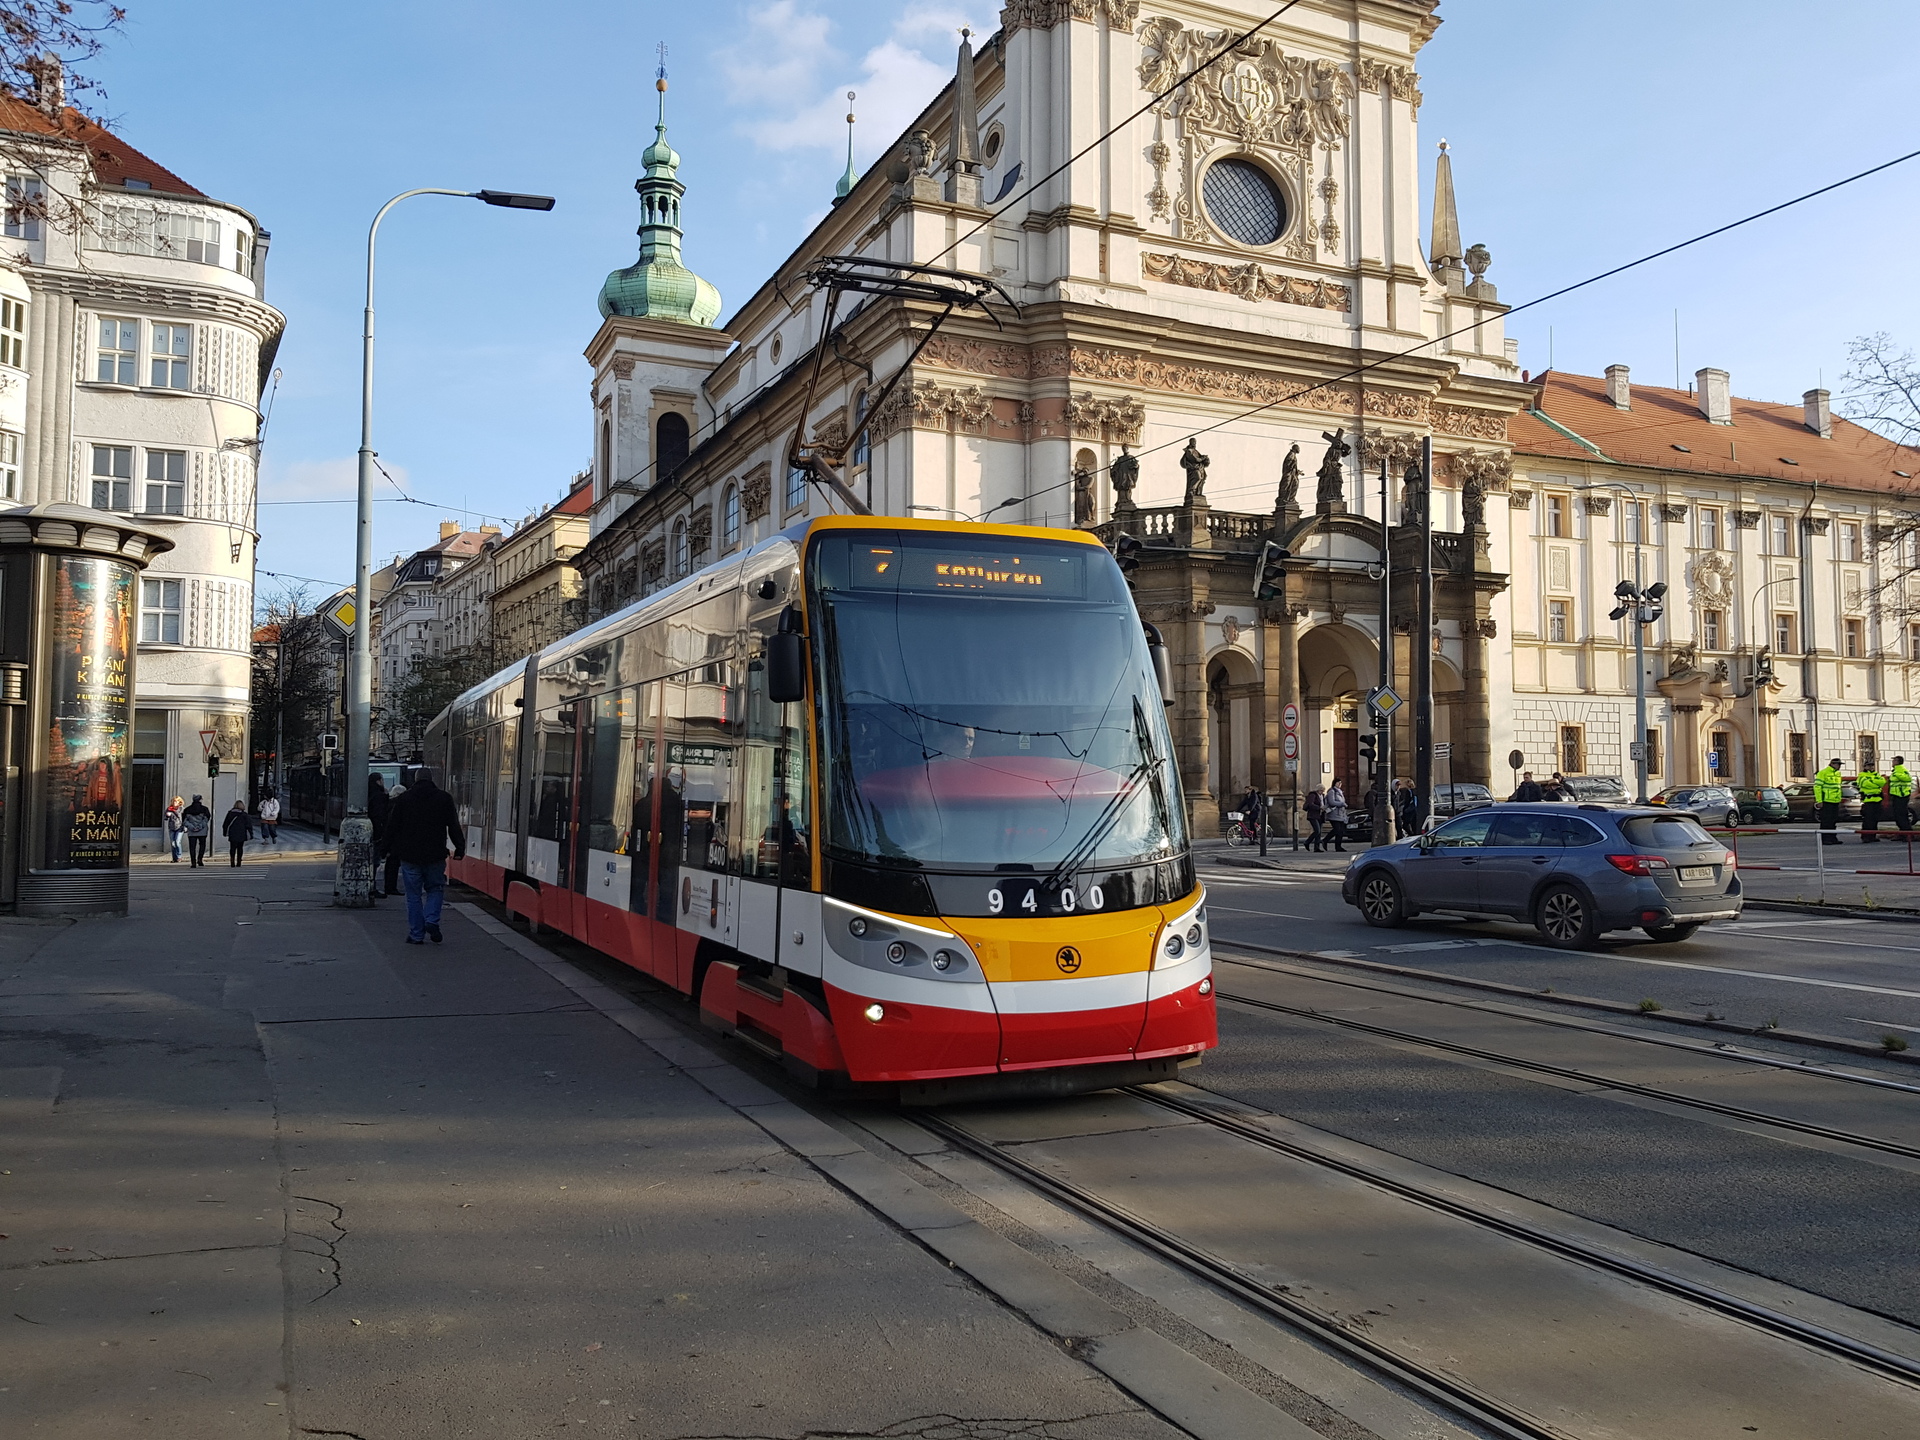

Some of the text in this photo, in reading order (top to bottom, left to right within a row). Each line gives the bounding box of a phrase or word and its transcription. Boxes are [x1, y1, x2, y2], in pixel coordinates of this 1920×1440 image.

[81, 655, 126, 672] PÁNÍ
[77, 670, 127, 687] K MÁNÍ
[1710, 754, 1717, 763] P
[75, 810, 120, 825] PŘÁNÍ
[71, 826, 121, 841] K MÁNÍ
[709, 843, 726, 866] 9400
